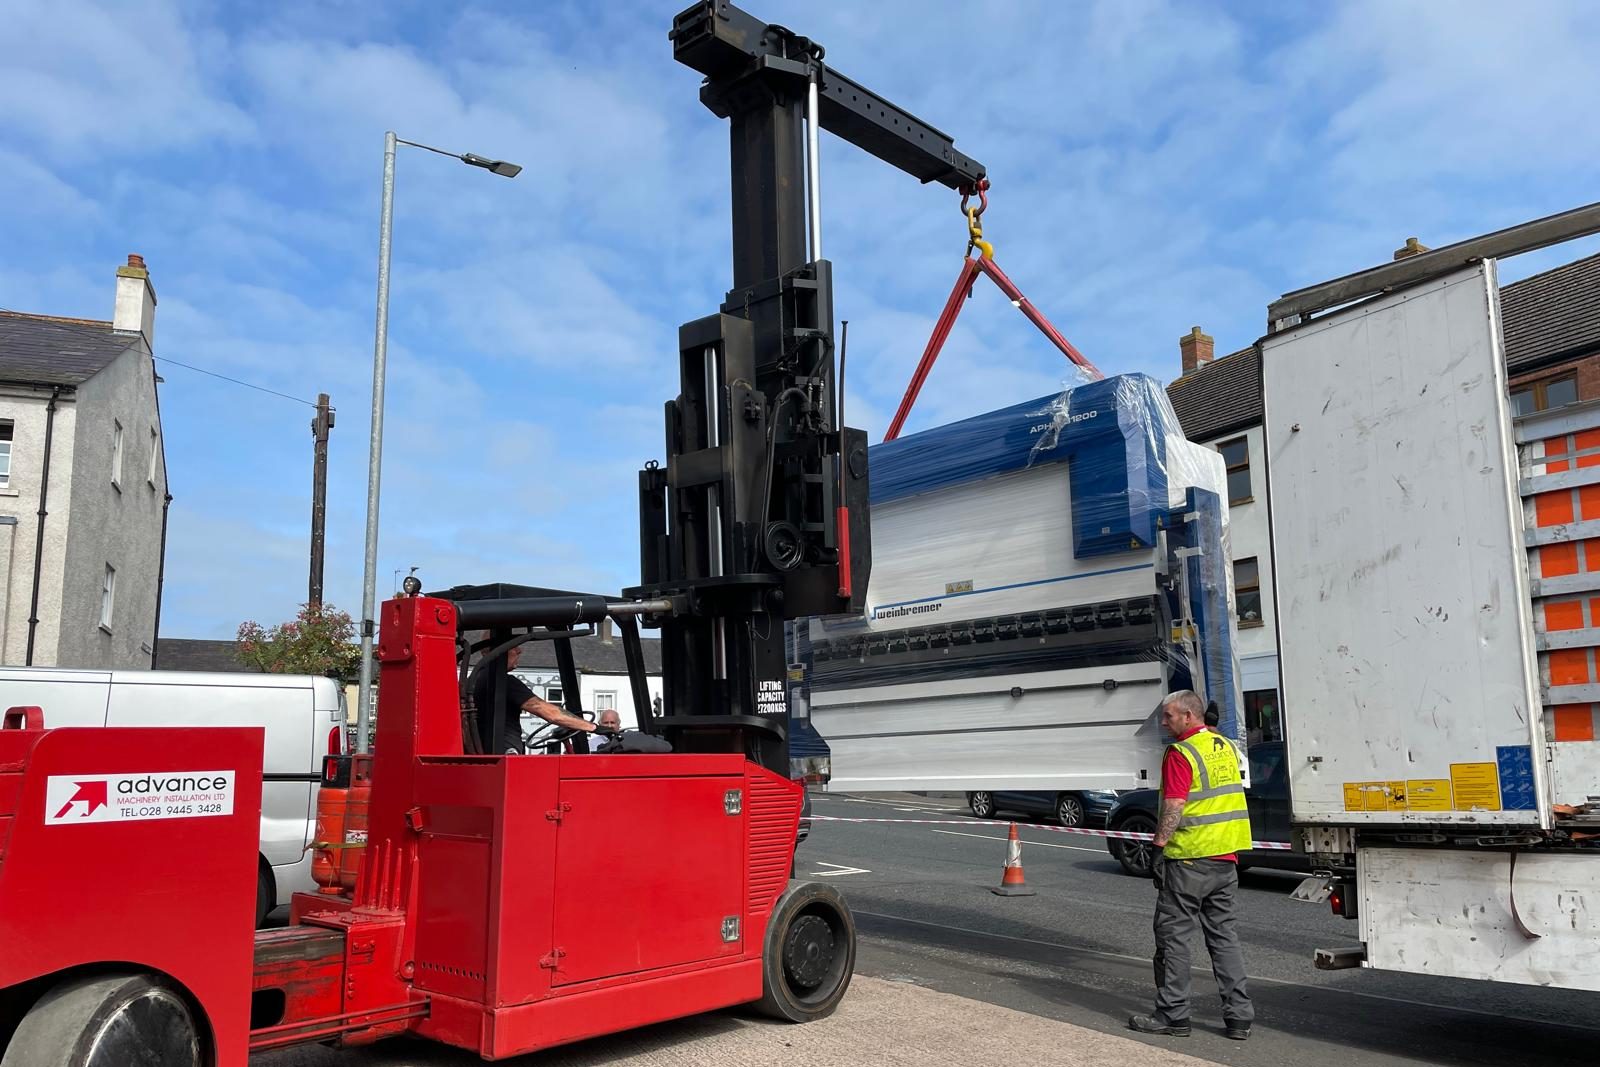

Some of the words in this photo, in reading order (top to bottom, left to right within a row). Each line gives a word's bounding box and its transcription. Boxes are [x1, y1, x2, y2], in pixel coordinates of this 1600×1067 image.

[877, 603, 942, 620] weinbrenner
[759, 680, 782, 691] LIFTING
[757, 691, 785, 702] CAPACITY
[117, 775, 227, 794] advance
[117, 796, 161, 805] MACHINERY
[164, 794, 211, 803] INSTALLATION
[213, 793, 225, 801] LTD
[166, 805, 193, 815] 9445
[197, 803, 222, 813] 3428
